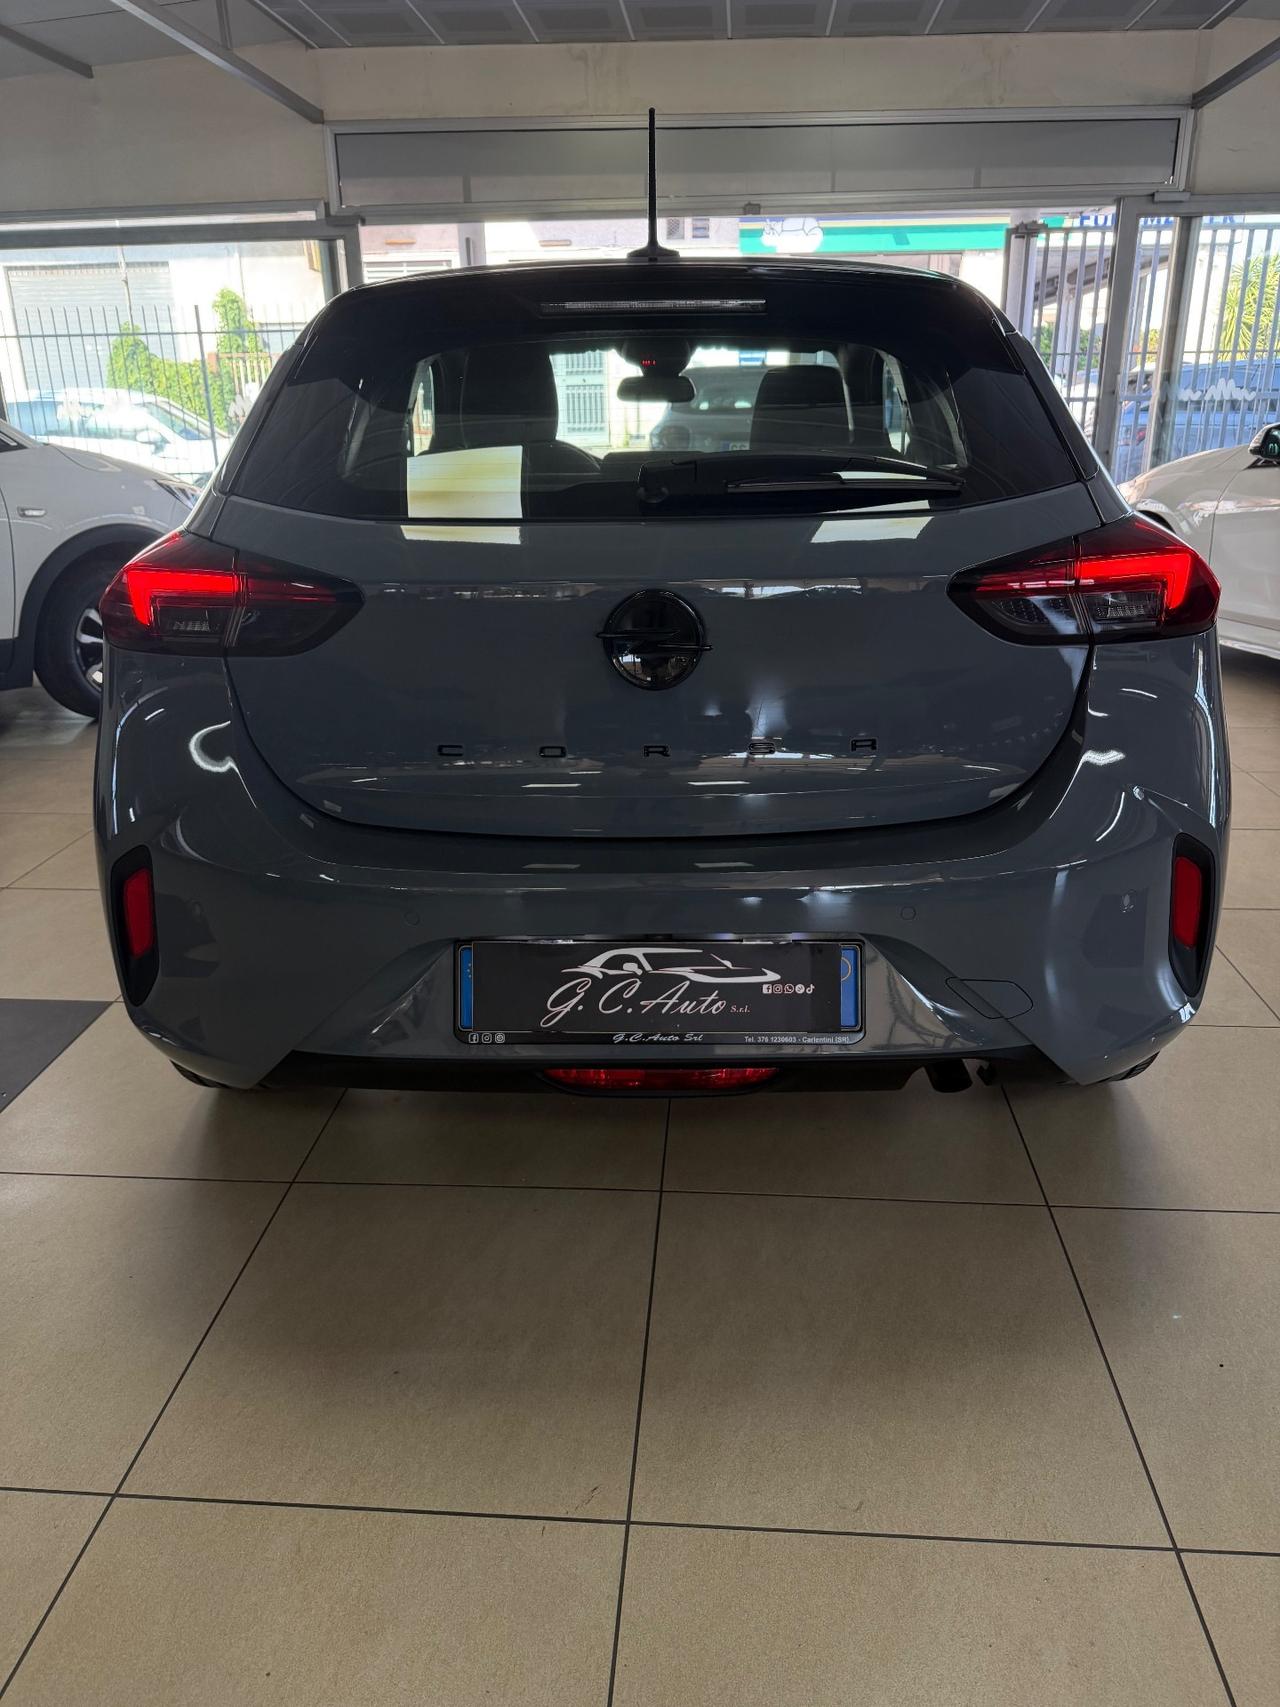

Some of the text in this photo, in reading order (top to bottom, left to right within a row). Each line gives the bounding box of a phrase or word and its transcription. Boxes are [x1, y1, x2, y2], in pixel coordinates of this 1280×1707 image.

[437, 738, 877, 757] CORSA
[540, 977, 592, 1028] G.
[598, 977, 641, 1015] C.
[640, 980, 727, 1015] Auto
[684, 1033, 704, 1042] Srl
